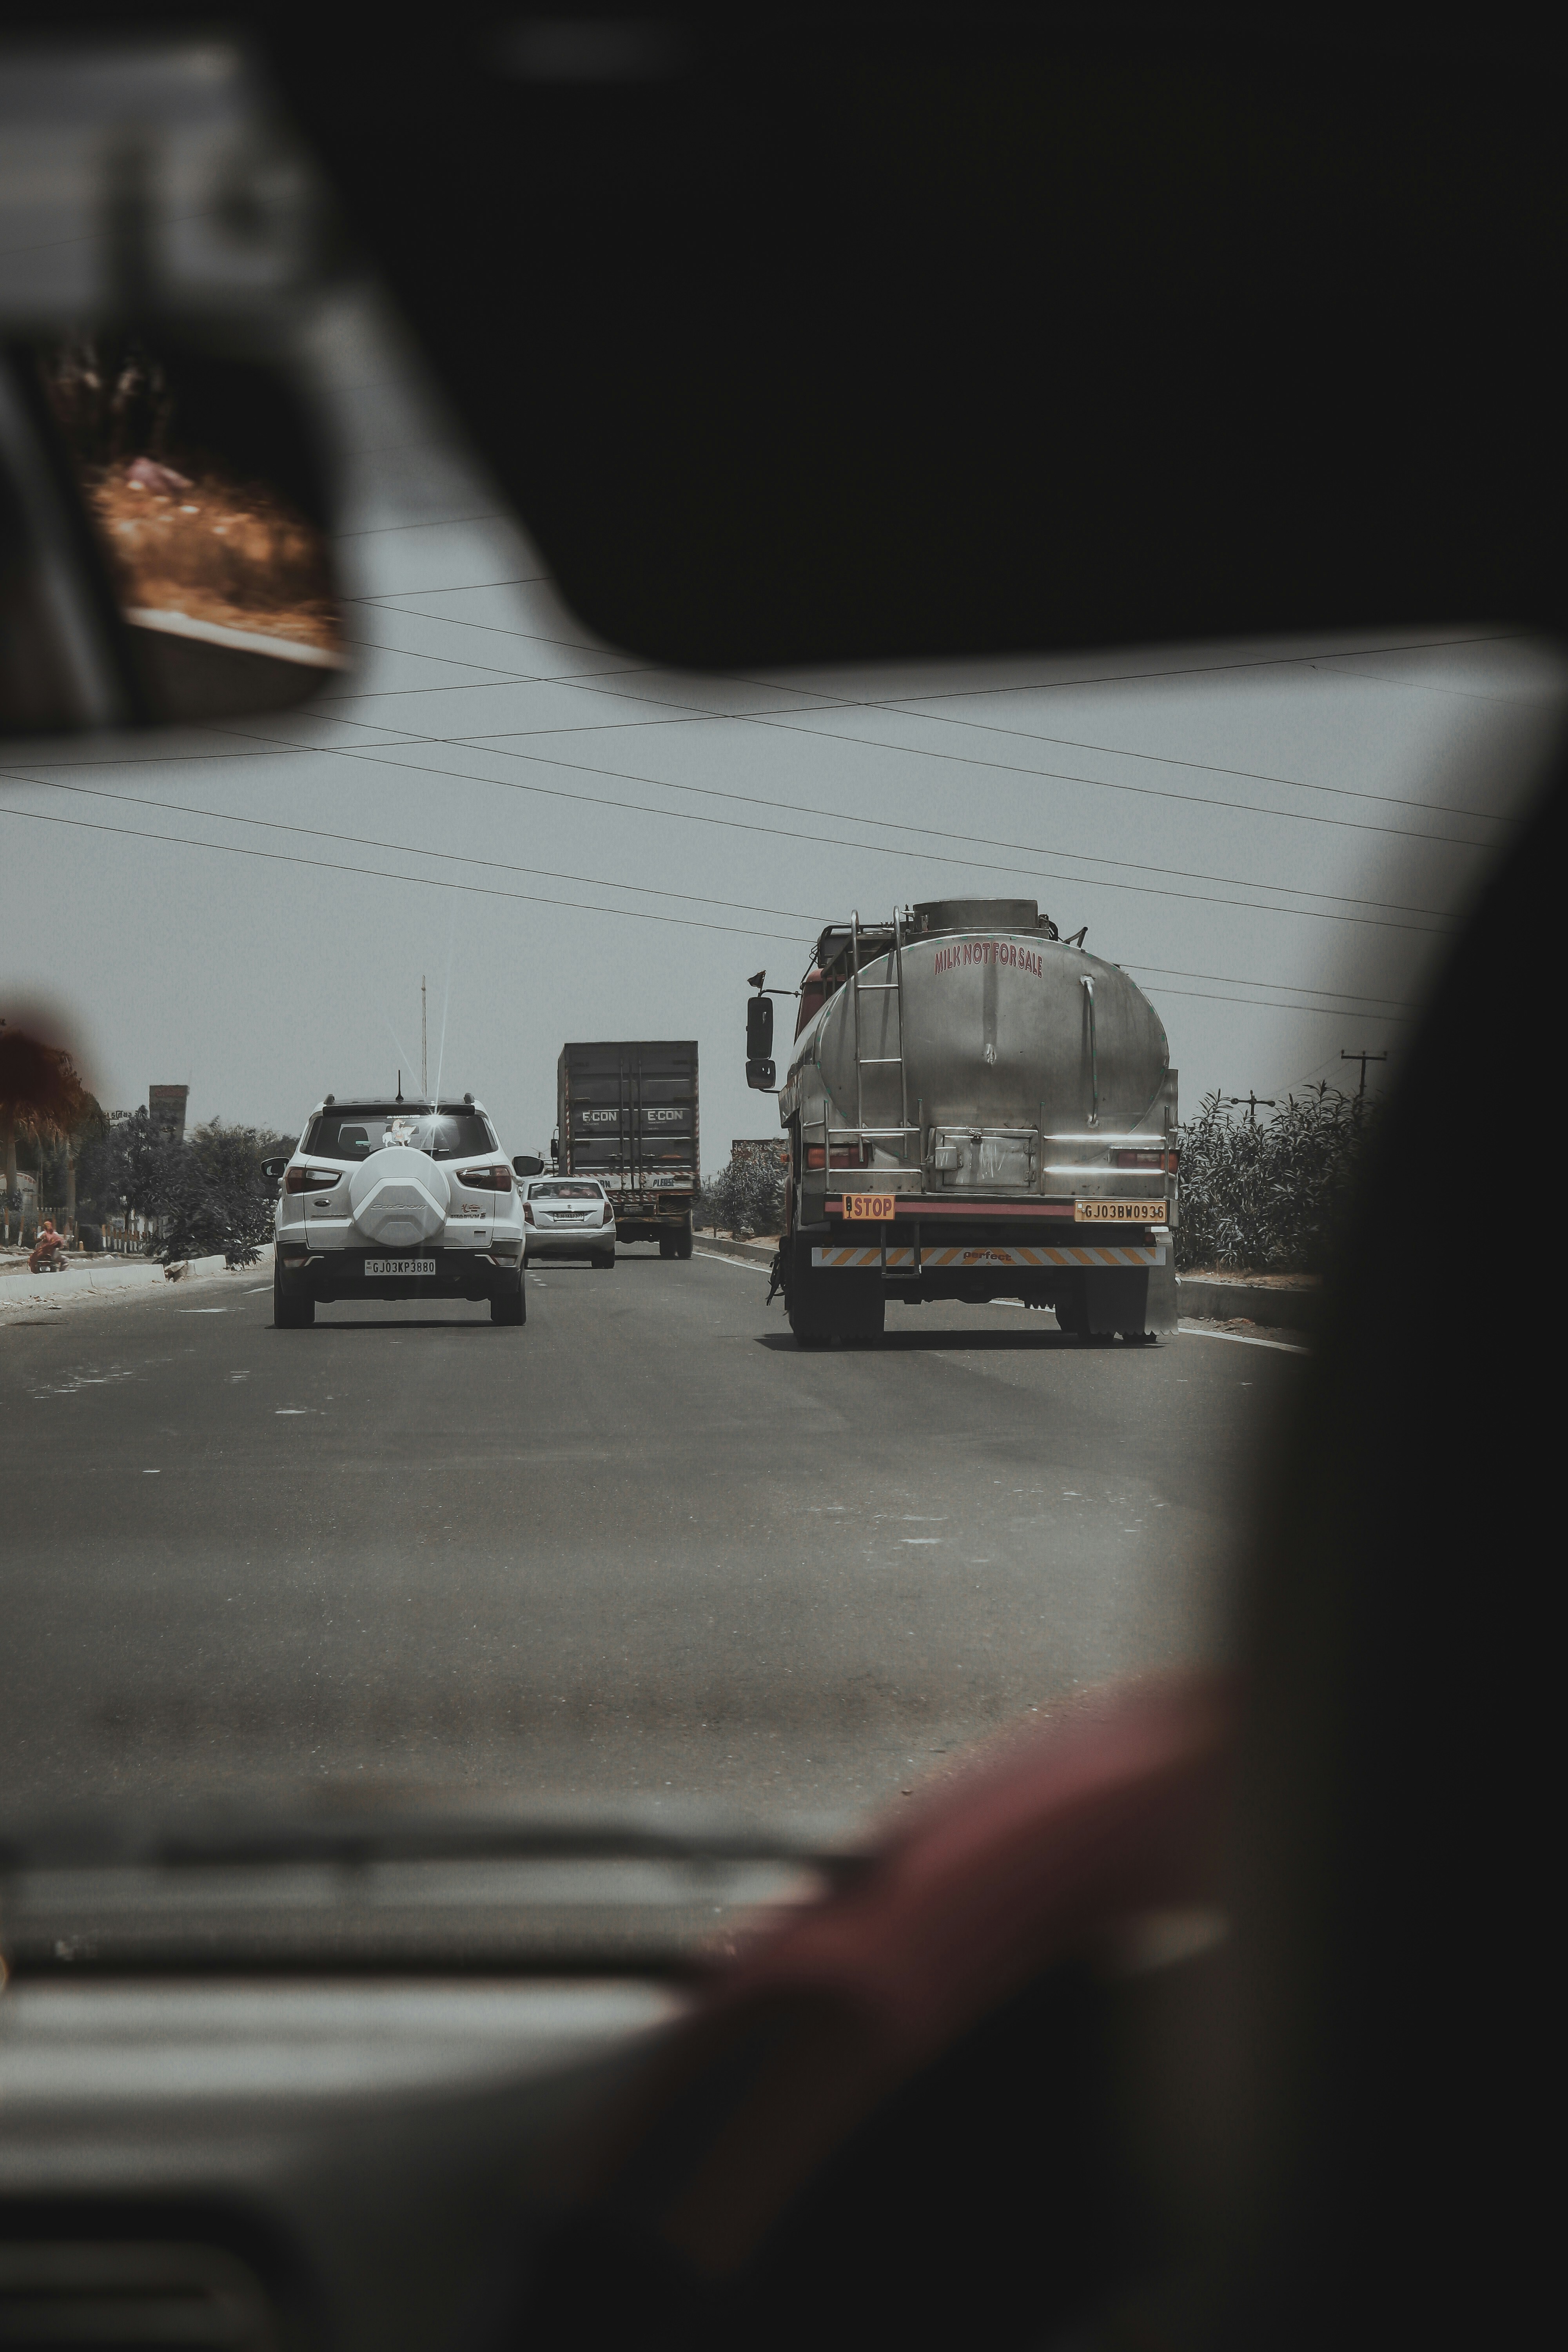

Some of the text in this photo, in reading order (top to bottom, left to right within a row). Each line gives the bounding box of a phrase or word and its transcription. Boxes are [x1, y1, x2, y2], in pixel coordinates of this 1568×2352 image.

[934, 942, 1043, 979] MILK NOT FOR SALE
[855, 1198, 892, 1216] STOP
[1085, 1205, 1163, 1218] GJ03BW0936
[963, 1251, 1012, 1261] perfect
[373, 1262, 434, 1273] GJ03KP3880
